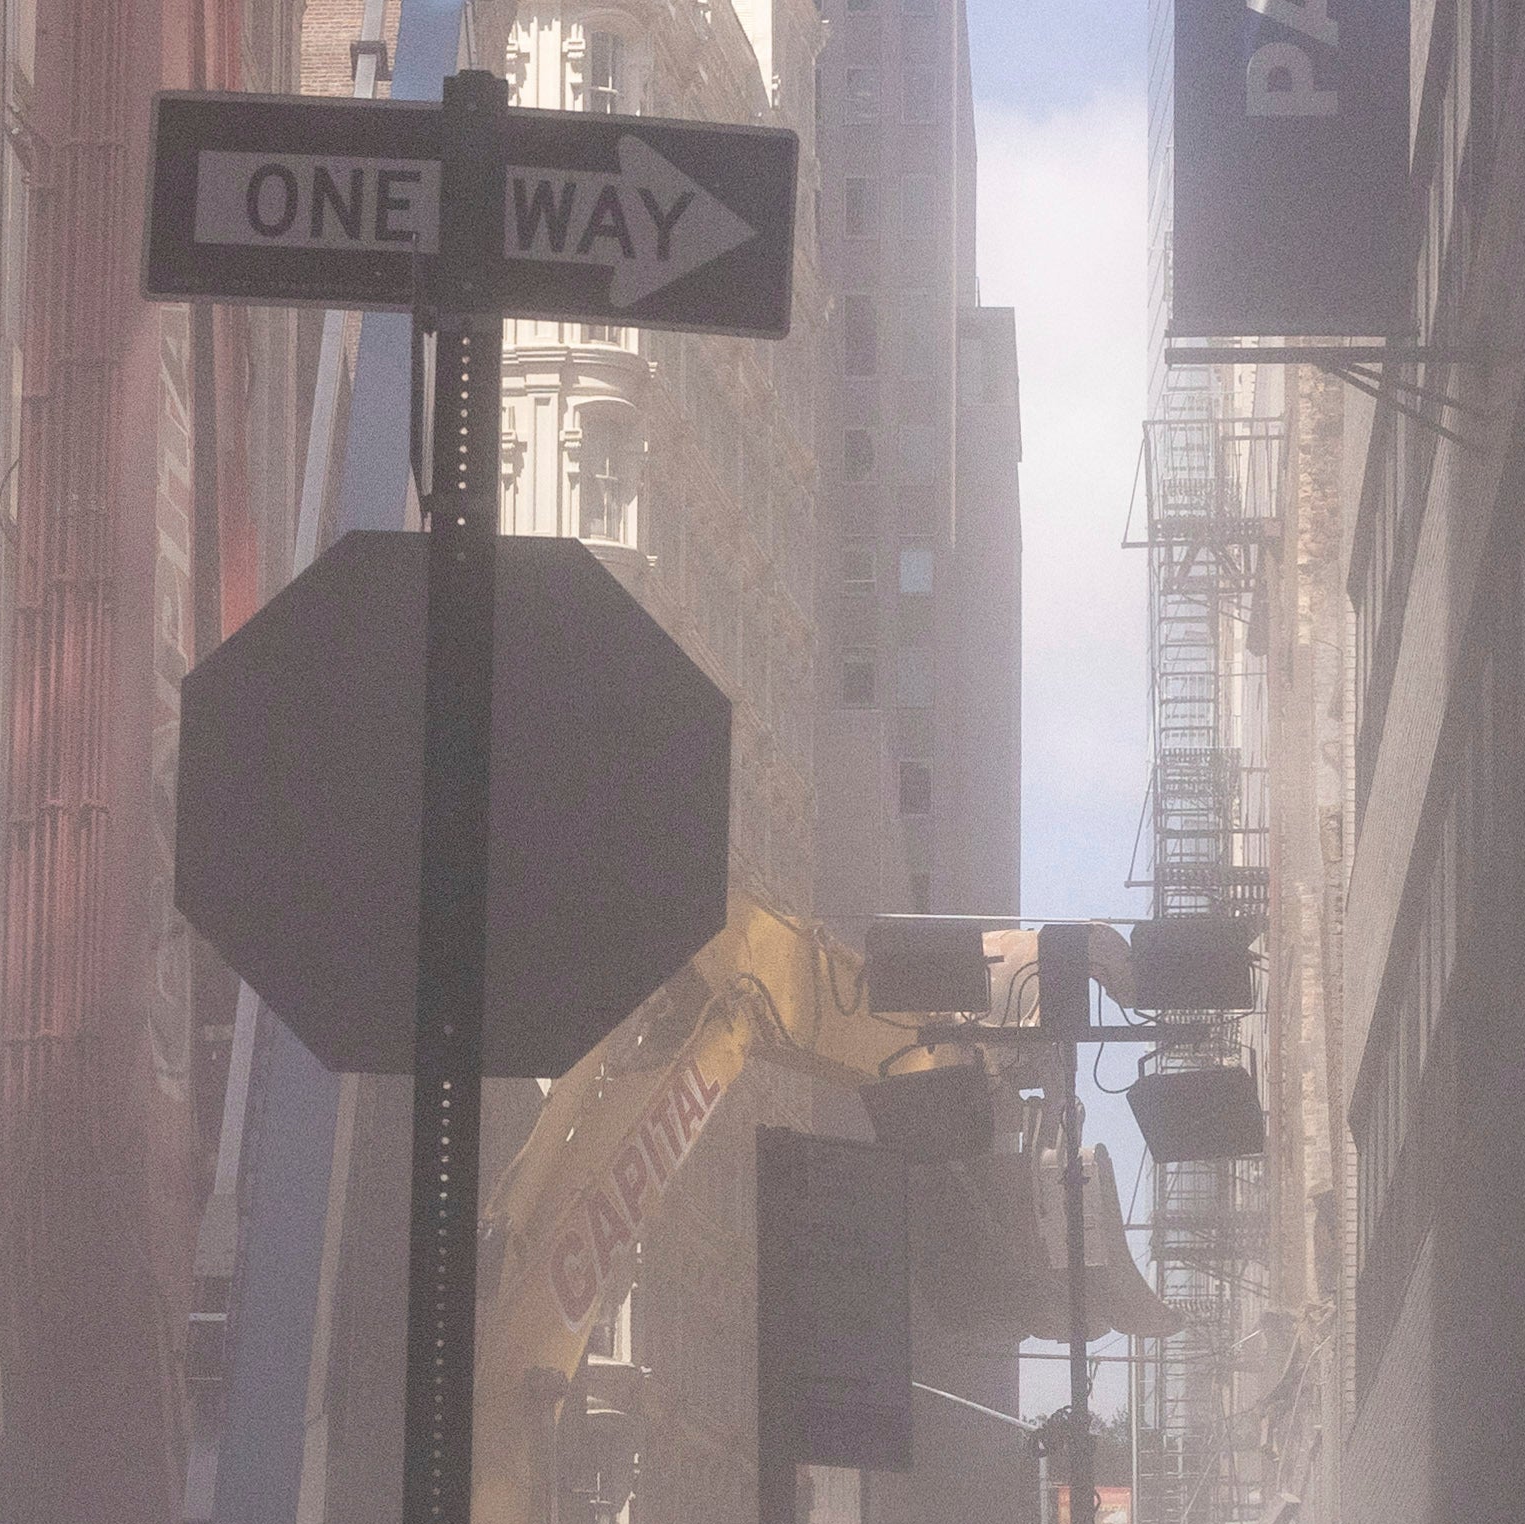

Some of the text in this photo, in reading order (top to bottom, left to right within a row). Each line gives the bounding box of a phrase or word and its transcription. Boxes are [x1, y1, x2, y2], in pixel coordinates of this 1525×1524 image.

[245, 162, 695, 262] ONE WAY
[550, 1060, 722, 1322] CAPITAL
